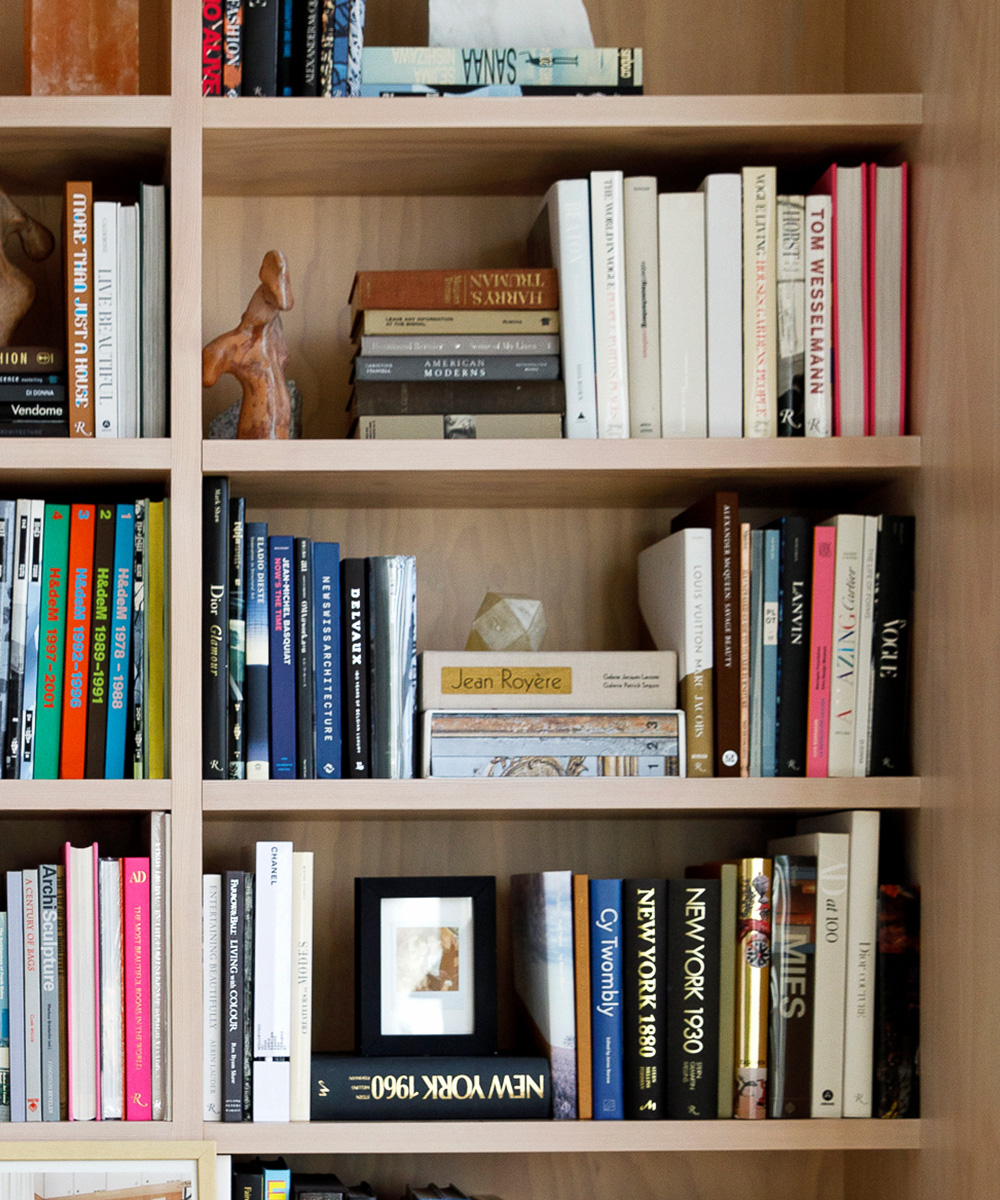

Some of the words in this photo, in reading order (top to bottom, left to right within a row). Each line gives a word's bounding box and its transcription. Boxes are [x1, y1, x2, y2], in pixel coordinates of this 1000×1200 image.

[203, 27, 221, 94] ALIVE
[461, 48, 517, 84] SANAA
[73, 193, 88, 245] MORE
[811, 208, 825, 251] TOM
[73, 248, 88, 293] THAN
[98, 269, 112, 307] LIVE
[470, 273, 544, 287] TRUMAN
[73, 297, 88, 340] JUST
[810, 259, 824, 394] WESSELMANN
[74, 342, 88, 354] A
[98, 311, 113, 405] BEAUTIFUL
[424, 359, 485, 367] AMERICAN
[74, 358, 89, 408] HOUSE
[424, 369, 486, 377] MODERNS
[11, 404, 63, 416] Vendome
[52, 510, 63, 520] 4
[78, 509, 89, 520] 3
[100, 509, 111, 519] 2
[257, 572, 265, 604] DIESTE
[274, 557, 282, 589] NOW'S
[282, 557, 291, 618] JEAN-MICHEL
[693, 565, 704, 600] LOUIS
[210, 584, 224, 615] Dior
[274, 590, 282, 608] THE
[790, 581, 804, 645] LANVIN
[283, 619, 291, 665] BASQUIAT
[693, 603, 704, 653] VUITTON
[210, 625, 224, 676] Glamour
[451, 668, 494, 690] Jean
[502, 668, 562, 693] Royère
[694, 658, 704, 689] MARC
[694, 694, 705, 738] JACOBS
[208, 885, 217, 961] ENTERTAINING
[637, 888, 656, 944] NEW
[685, 888, 705, 941] NEW
[638, 946, 656, 1009] YORK
[684, 944, 704, 1001] YORK
[779, 933, 807, 1019] MIES
[857, 942, 871, 972] Dior
[208, 963, 217, 1030] BEAUTIFULLY
[856, 972, 867, 1019] COUTURE
[209, 1039, 217, 1060] AERIN
[638, 1014, 656, 1058] 1880
[683, 1007, 704, 1054] 1930
[209, 1061, 217, 1094] LAUDER
[371, 1075, 419, 1099] 1960
[422, 1075, 485, 1099] YORK
[487, 1075, 544, 1098] NEW
